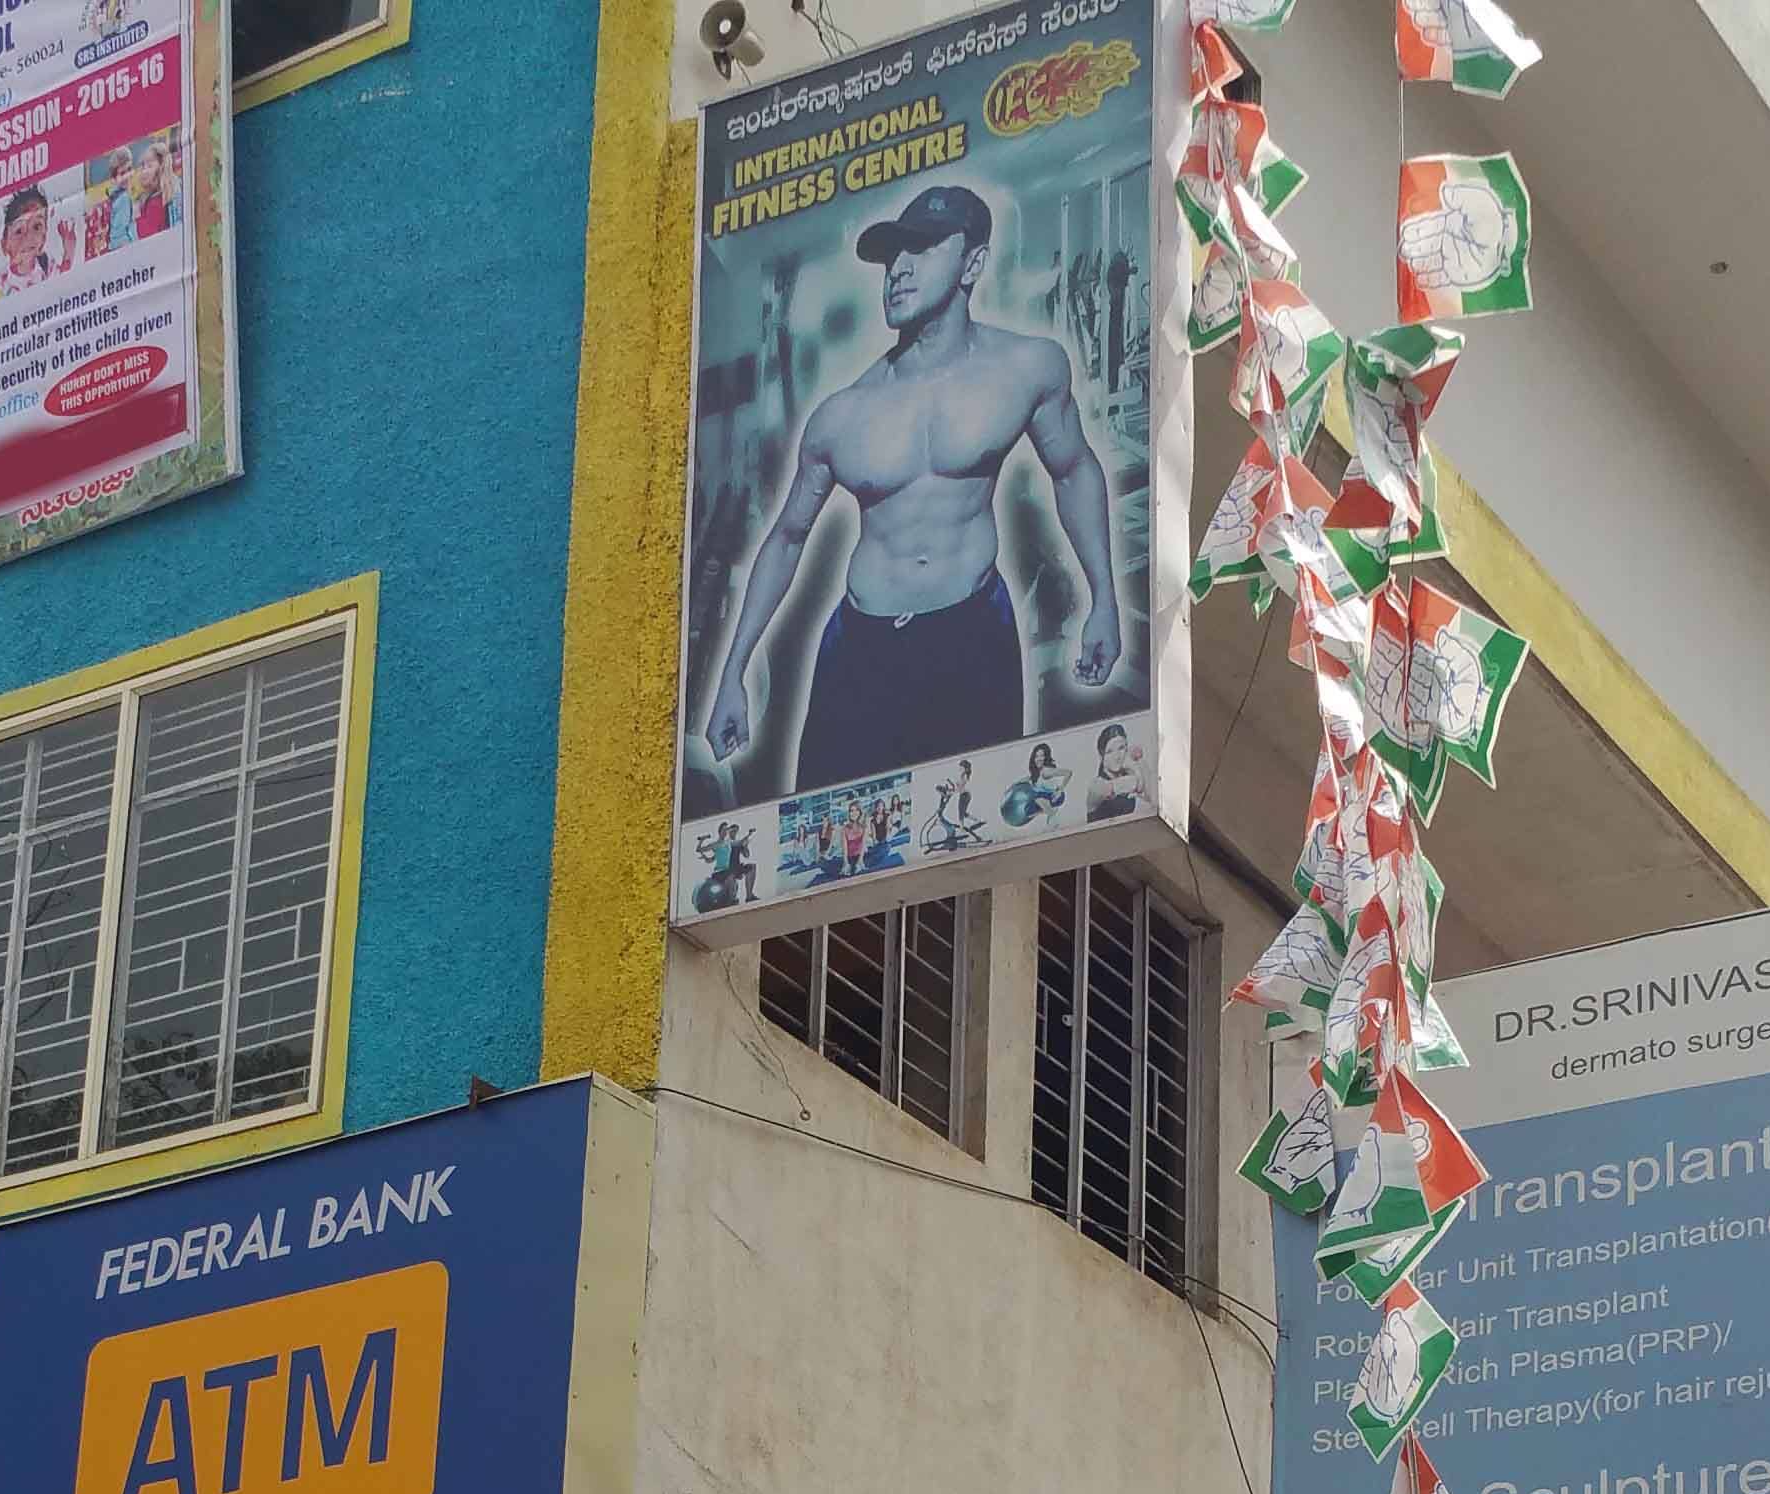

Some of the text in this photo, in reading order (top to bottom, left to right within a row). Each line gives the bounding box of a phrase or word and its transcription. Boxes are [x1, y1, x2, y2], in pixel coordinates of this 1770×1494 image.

[78, 53, 163, 115] 2015-16
[734, 95, 943, 190] INTERNATIONAL
[711, 124, 967, 238] FITNESS CENTRE
[52, 349, 64, 369] of
[69, 343, 90, 361] the
[96, 324, 128, 352] child
[135, 311, 171, 340] given
[1552, 1040, 1675, 1079] dermato
[95, 1165, 458, 1300] FEDERAL BANK
[1459, 1254, 1516, 1282] Unit
[1506, 1285, 1669, 1330] Transplant
[1465, 1389, 1644, 1432] Therapy(for
[1656, 1377, 1714, 1405] hair
